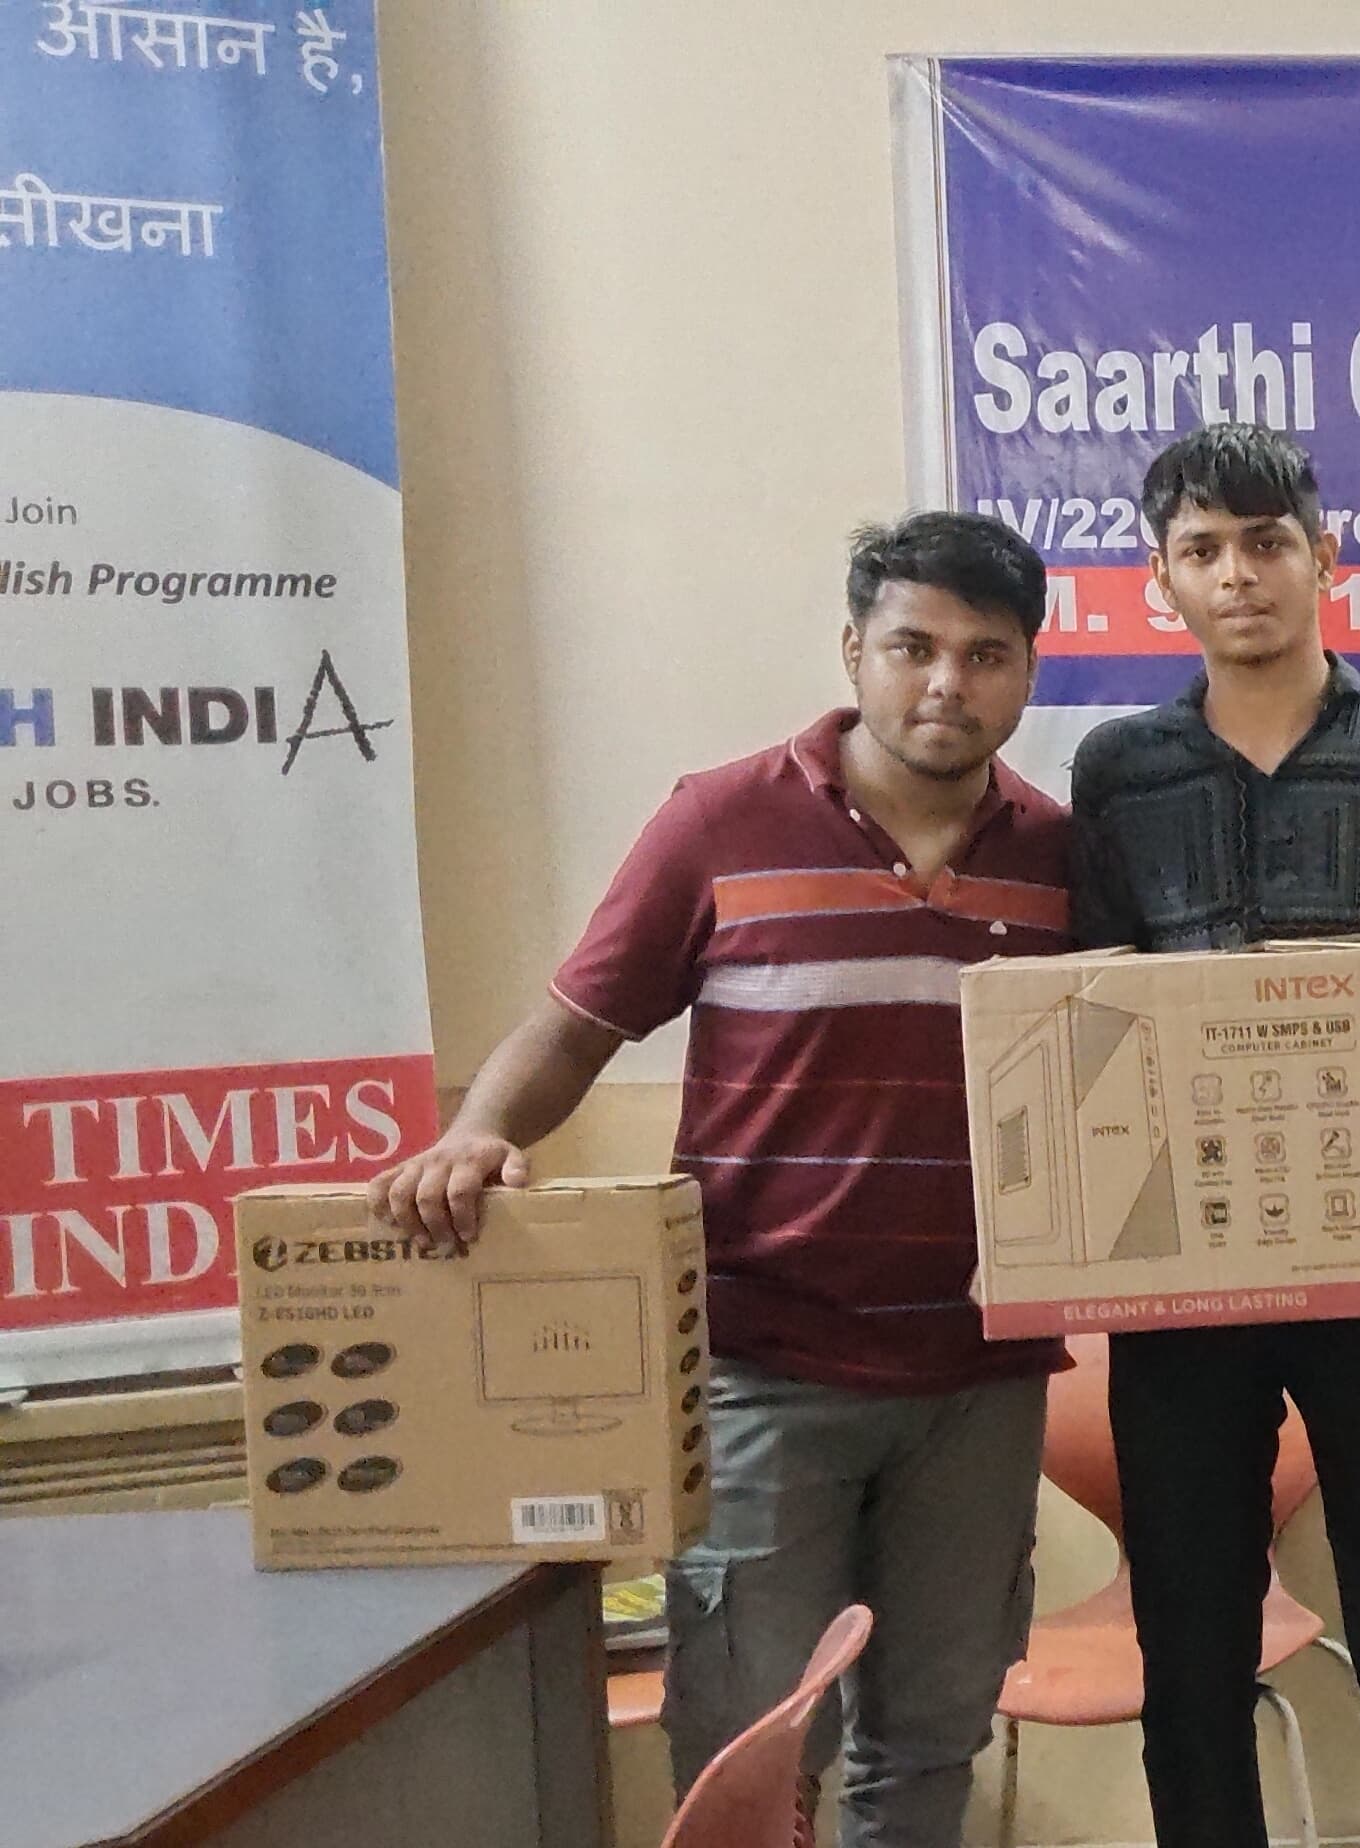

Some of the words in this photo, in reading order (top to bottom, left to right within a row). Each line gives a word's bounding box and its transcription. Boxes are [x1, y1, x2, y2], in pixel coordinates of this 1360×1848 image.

[973, 320, 1316, 433] Saarthi
[6, 496, 77, 525] Join
[87, 563, 337, 604] Programme
[92, 649, 394, 775] INDIA
[1271, 1020, 1309, 1037] SMPS
[1312, 1020, 1322, 1035] &
[1325, 1018, 1351, 1034] USB
[22, 1079, 402, 1186] TIMES
[2, 1197, 238, 1301] IND
[1063, 1299, 1149, 1321] ELEGANT
[1171, 1296, 1223, 1315] LONG
[1228, 1291, 1308, 1311] LASTING
